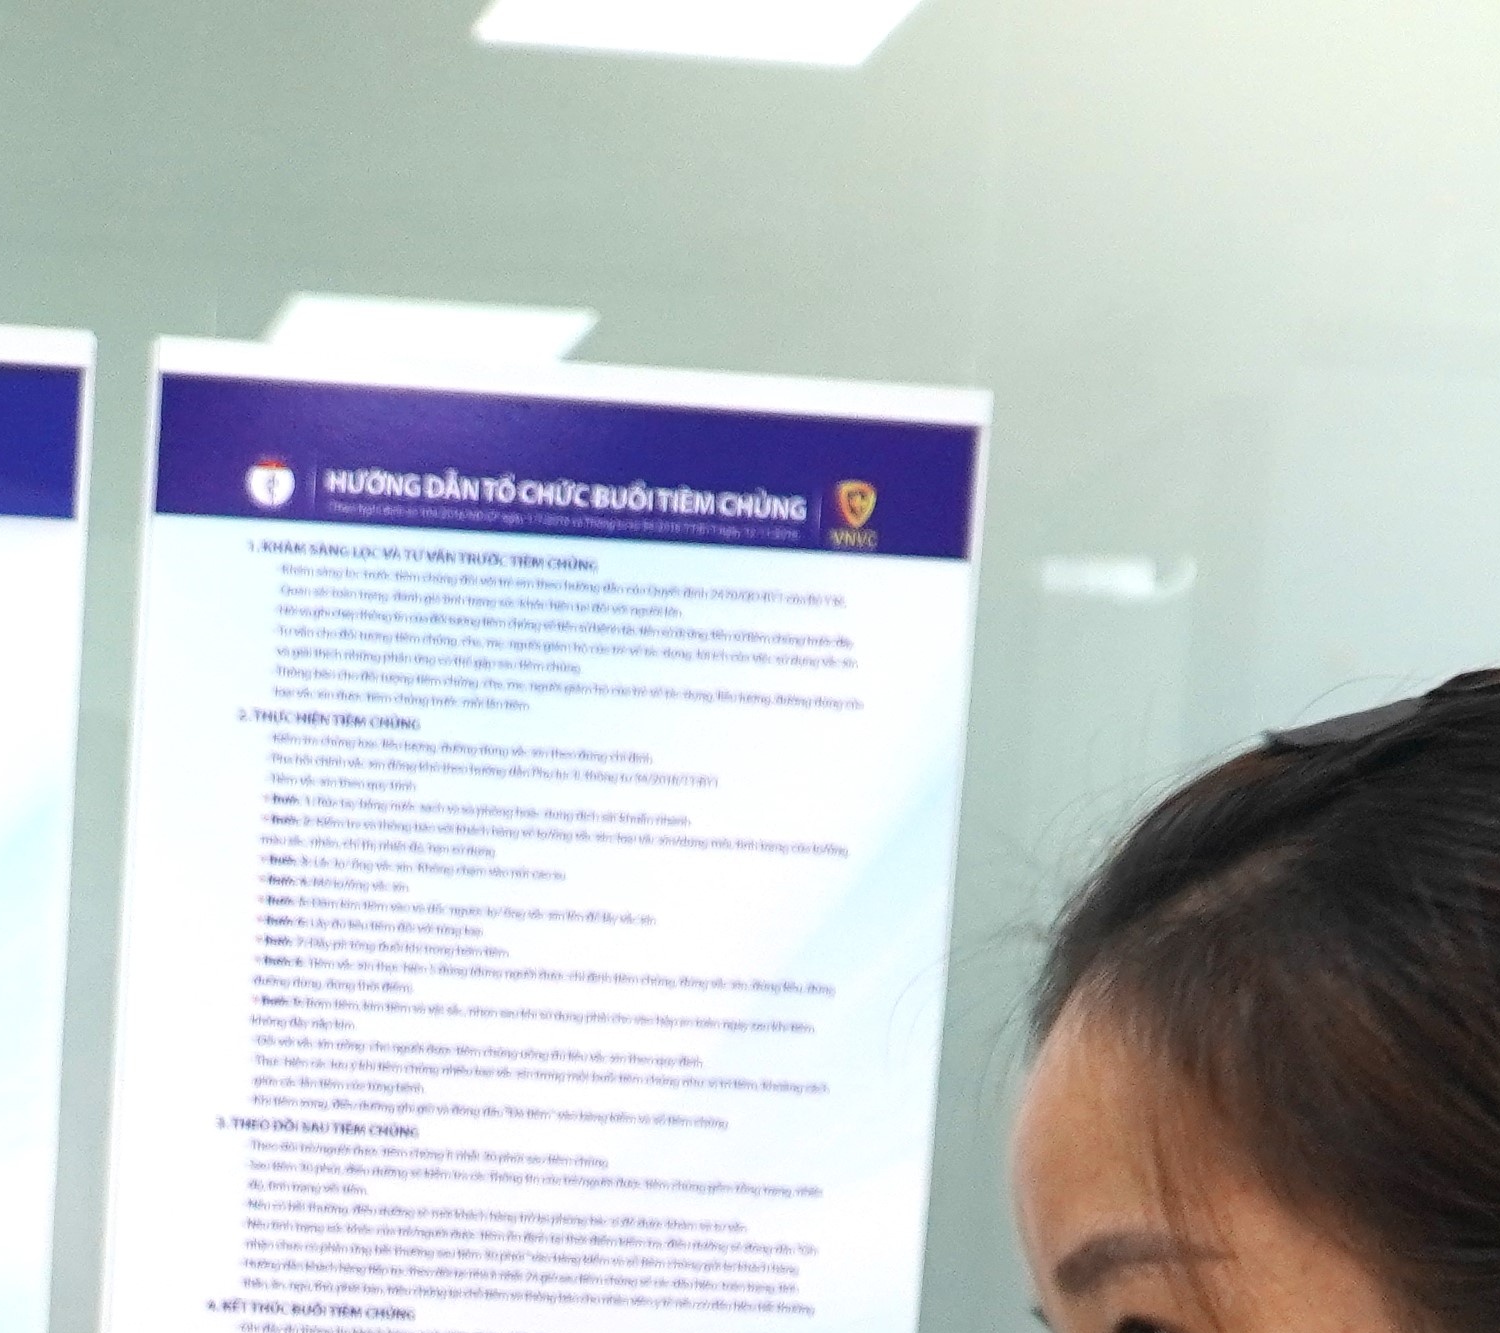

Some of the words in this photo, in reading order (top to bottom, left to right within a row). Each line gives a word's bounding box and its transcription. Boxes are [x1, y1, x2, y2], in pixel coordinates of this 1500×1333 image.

[326, 463, 421, 500] HƯỚNG
[422, 465, 480, 504] DẪN
[481, 471, 516, 506] TỔ
[518, 474, 590, 510] CHỨC
[591, 475, 653, 514] BUỔI
[655, 481, 716, 518] TIÊM
[719, 484, 808, 523] CHỦNG
[831, 528, 879, 551] VNVC
